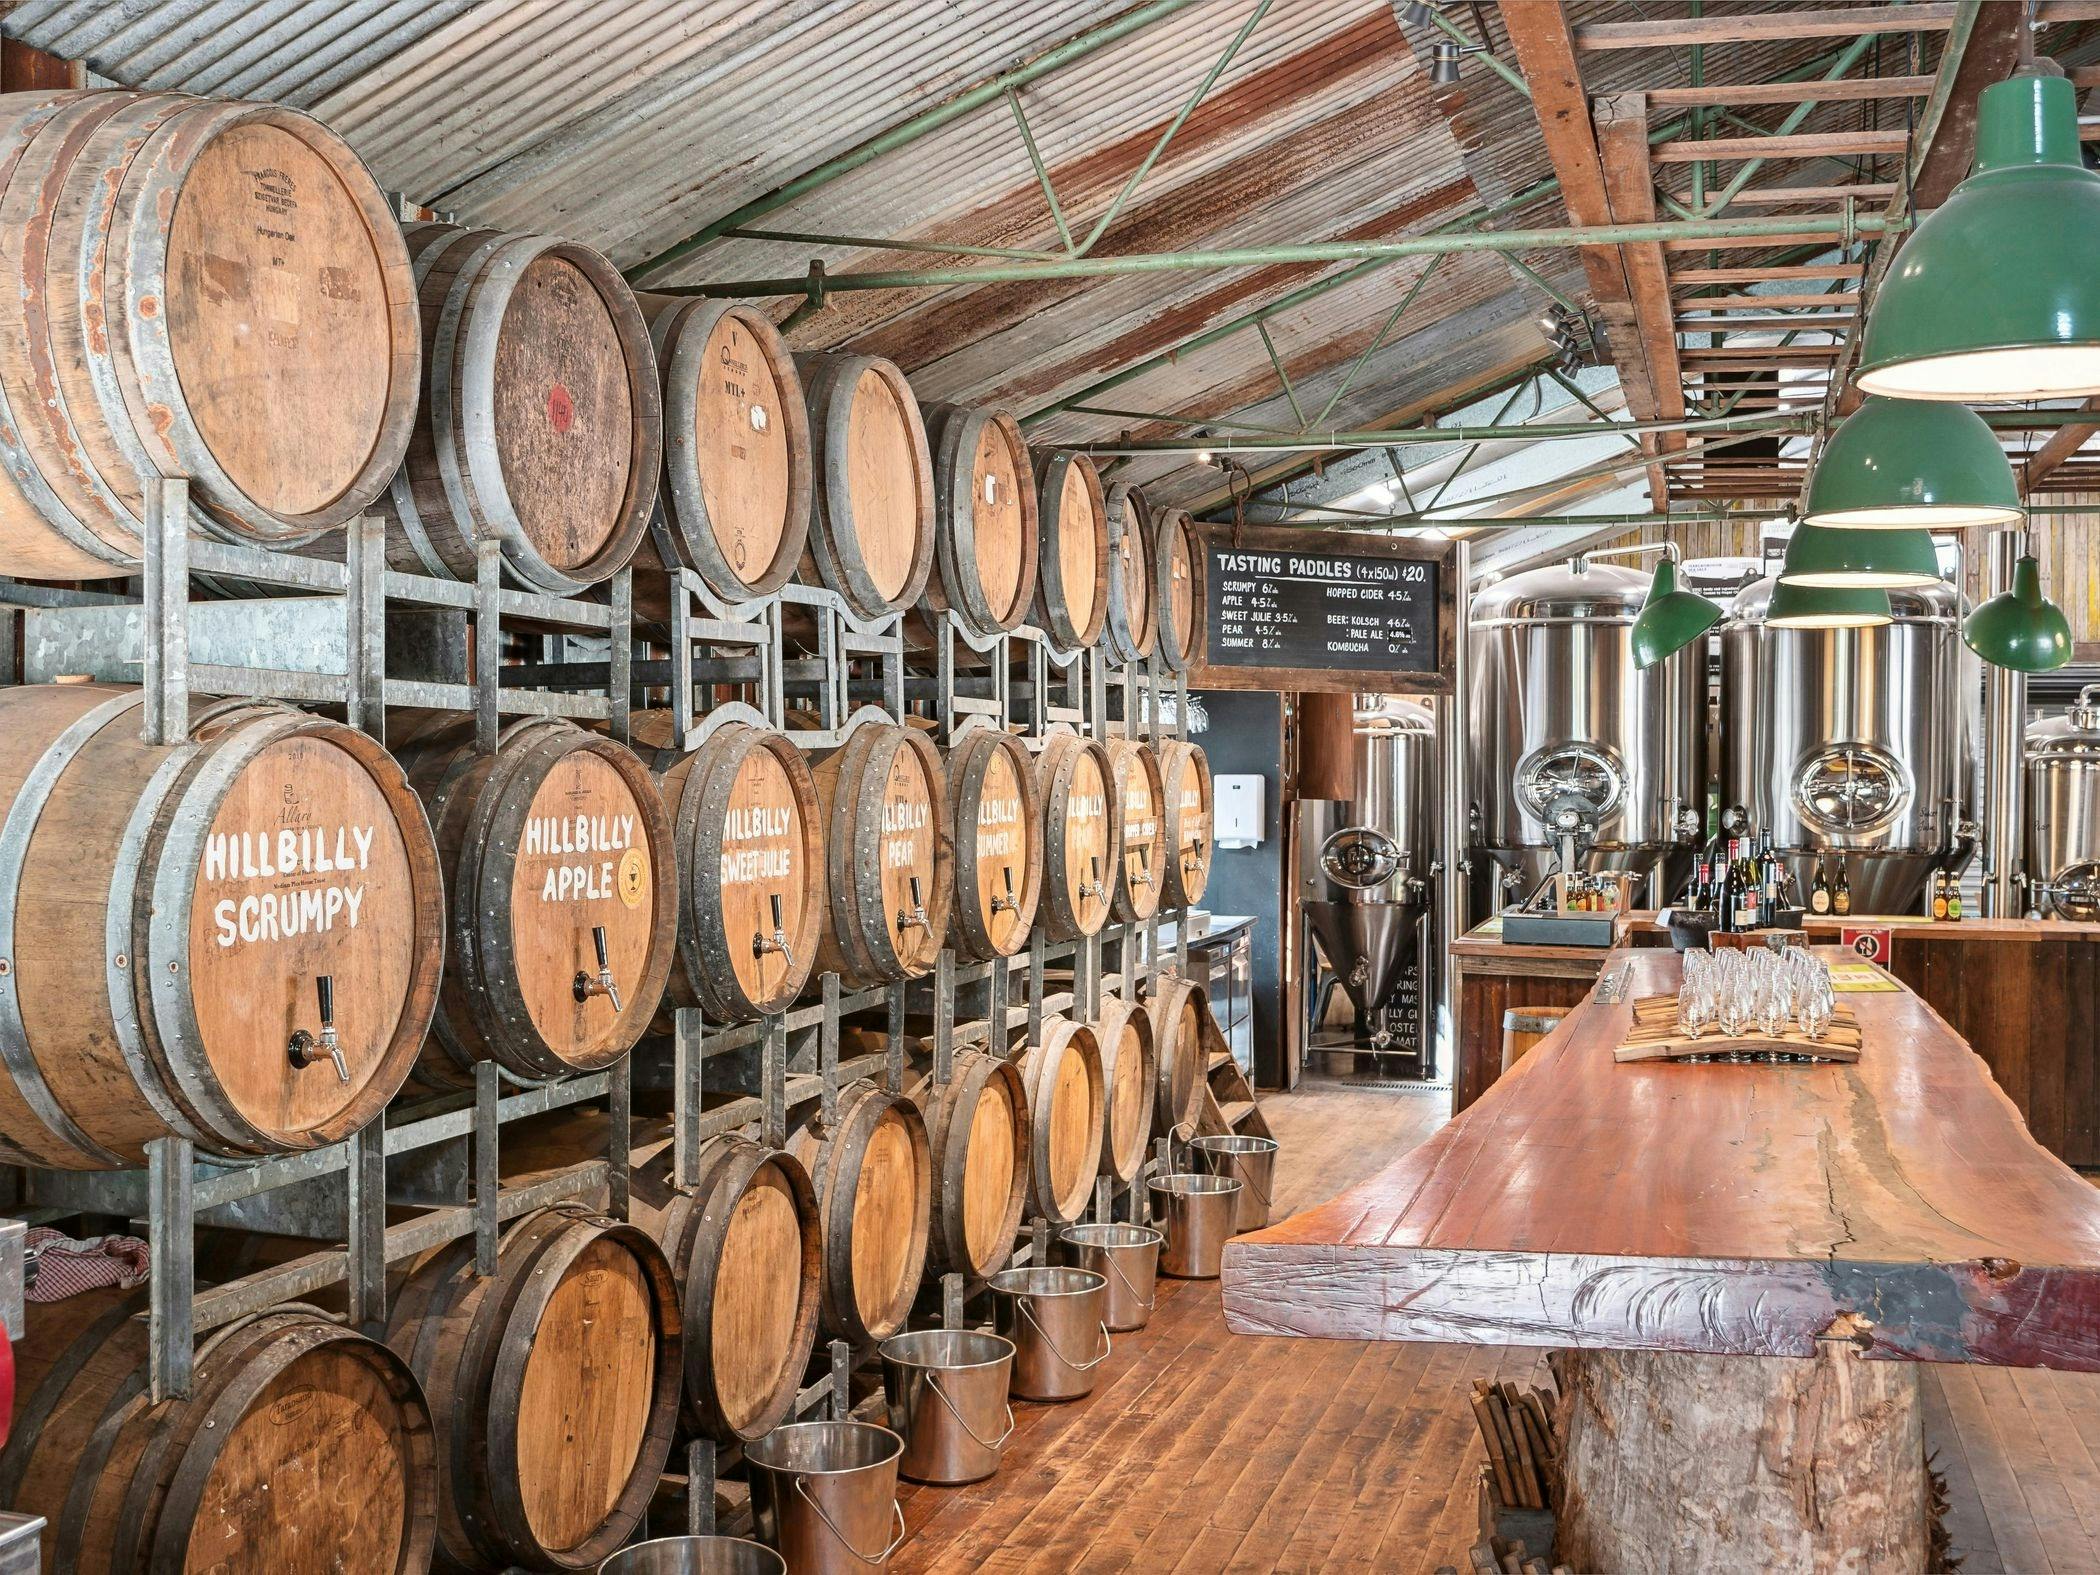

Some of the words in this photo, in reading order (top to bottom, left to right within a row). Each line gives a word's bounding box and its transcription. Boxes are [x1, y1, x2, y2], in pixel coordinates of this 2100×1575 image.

[1217, 554, 1281, 574] TASTING
[1289, 558, 1351, 578] PADDLES
[1222, 581, 1257, 593] SCRUMPY
[1326, 587, 1357, 599] HOPPED
[1360, 589, 1384, 600] CIDER
[1222, 595, 1243, 606] APPLE
[1220, 610, 1248, 621] SWEET
[1250, 611, 1272, 622] JULIE
[1351, 616, 1380, 626] KOLSCH
[1222, 624, 1243, 635] PEAR
[1350, 629, 1368, 639] PALE
[1370, 630, 1383, 640] ALE
[1221, 637, 1254, 648] SUMMER
[1327, 641, 1369, 652] KOMBUCHA
[526, 814, 634, 855] HILLBILLY
[206, 826, 374, 881] HILLBILLY
[888, 840, 913, 868] PEAR
[720, 850, 759, 885] SWEET
[761, 849, 791, 878] JULIE
[542, 862, 613, 902] APPLE
[214, 886, 364, 947] SCRUMPY
